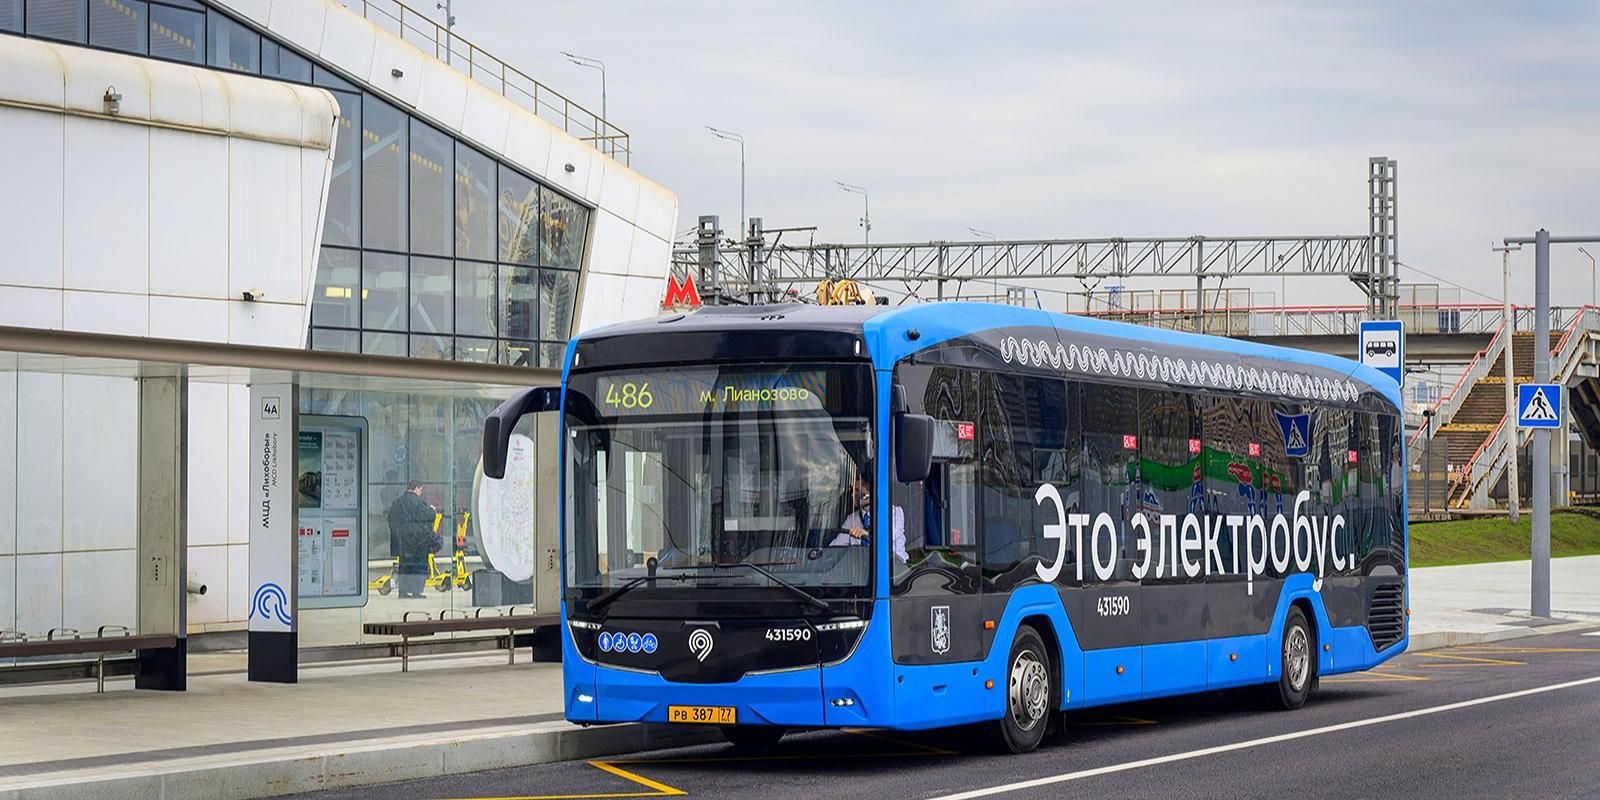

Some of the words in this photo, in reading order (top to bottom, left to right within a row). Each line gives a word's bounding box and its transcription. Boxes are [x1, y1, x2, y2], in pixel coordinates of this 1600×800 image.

[605, 382, 653, 409] 486
[699, 390, 716, 403] м.
[722, 385, 809, 402] Лианозово
[262, 432, 271, 498] «Лихоборы»
[262, 500, 271, 529] МЦД
[1034, 483, 1118, 582] Это
[1131, 489, 1355, 596] электробус.
[1096, 595, 1130, 617] 431590
[765, 628, 811, 641] 431590
[674, 710, 688, 721] РВ
[692, 708, 714, 721] 387
[720, 708, 732, 719] 77
